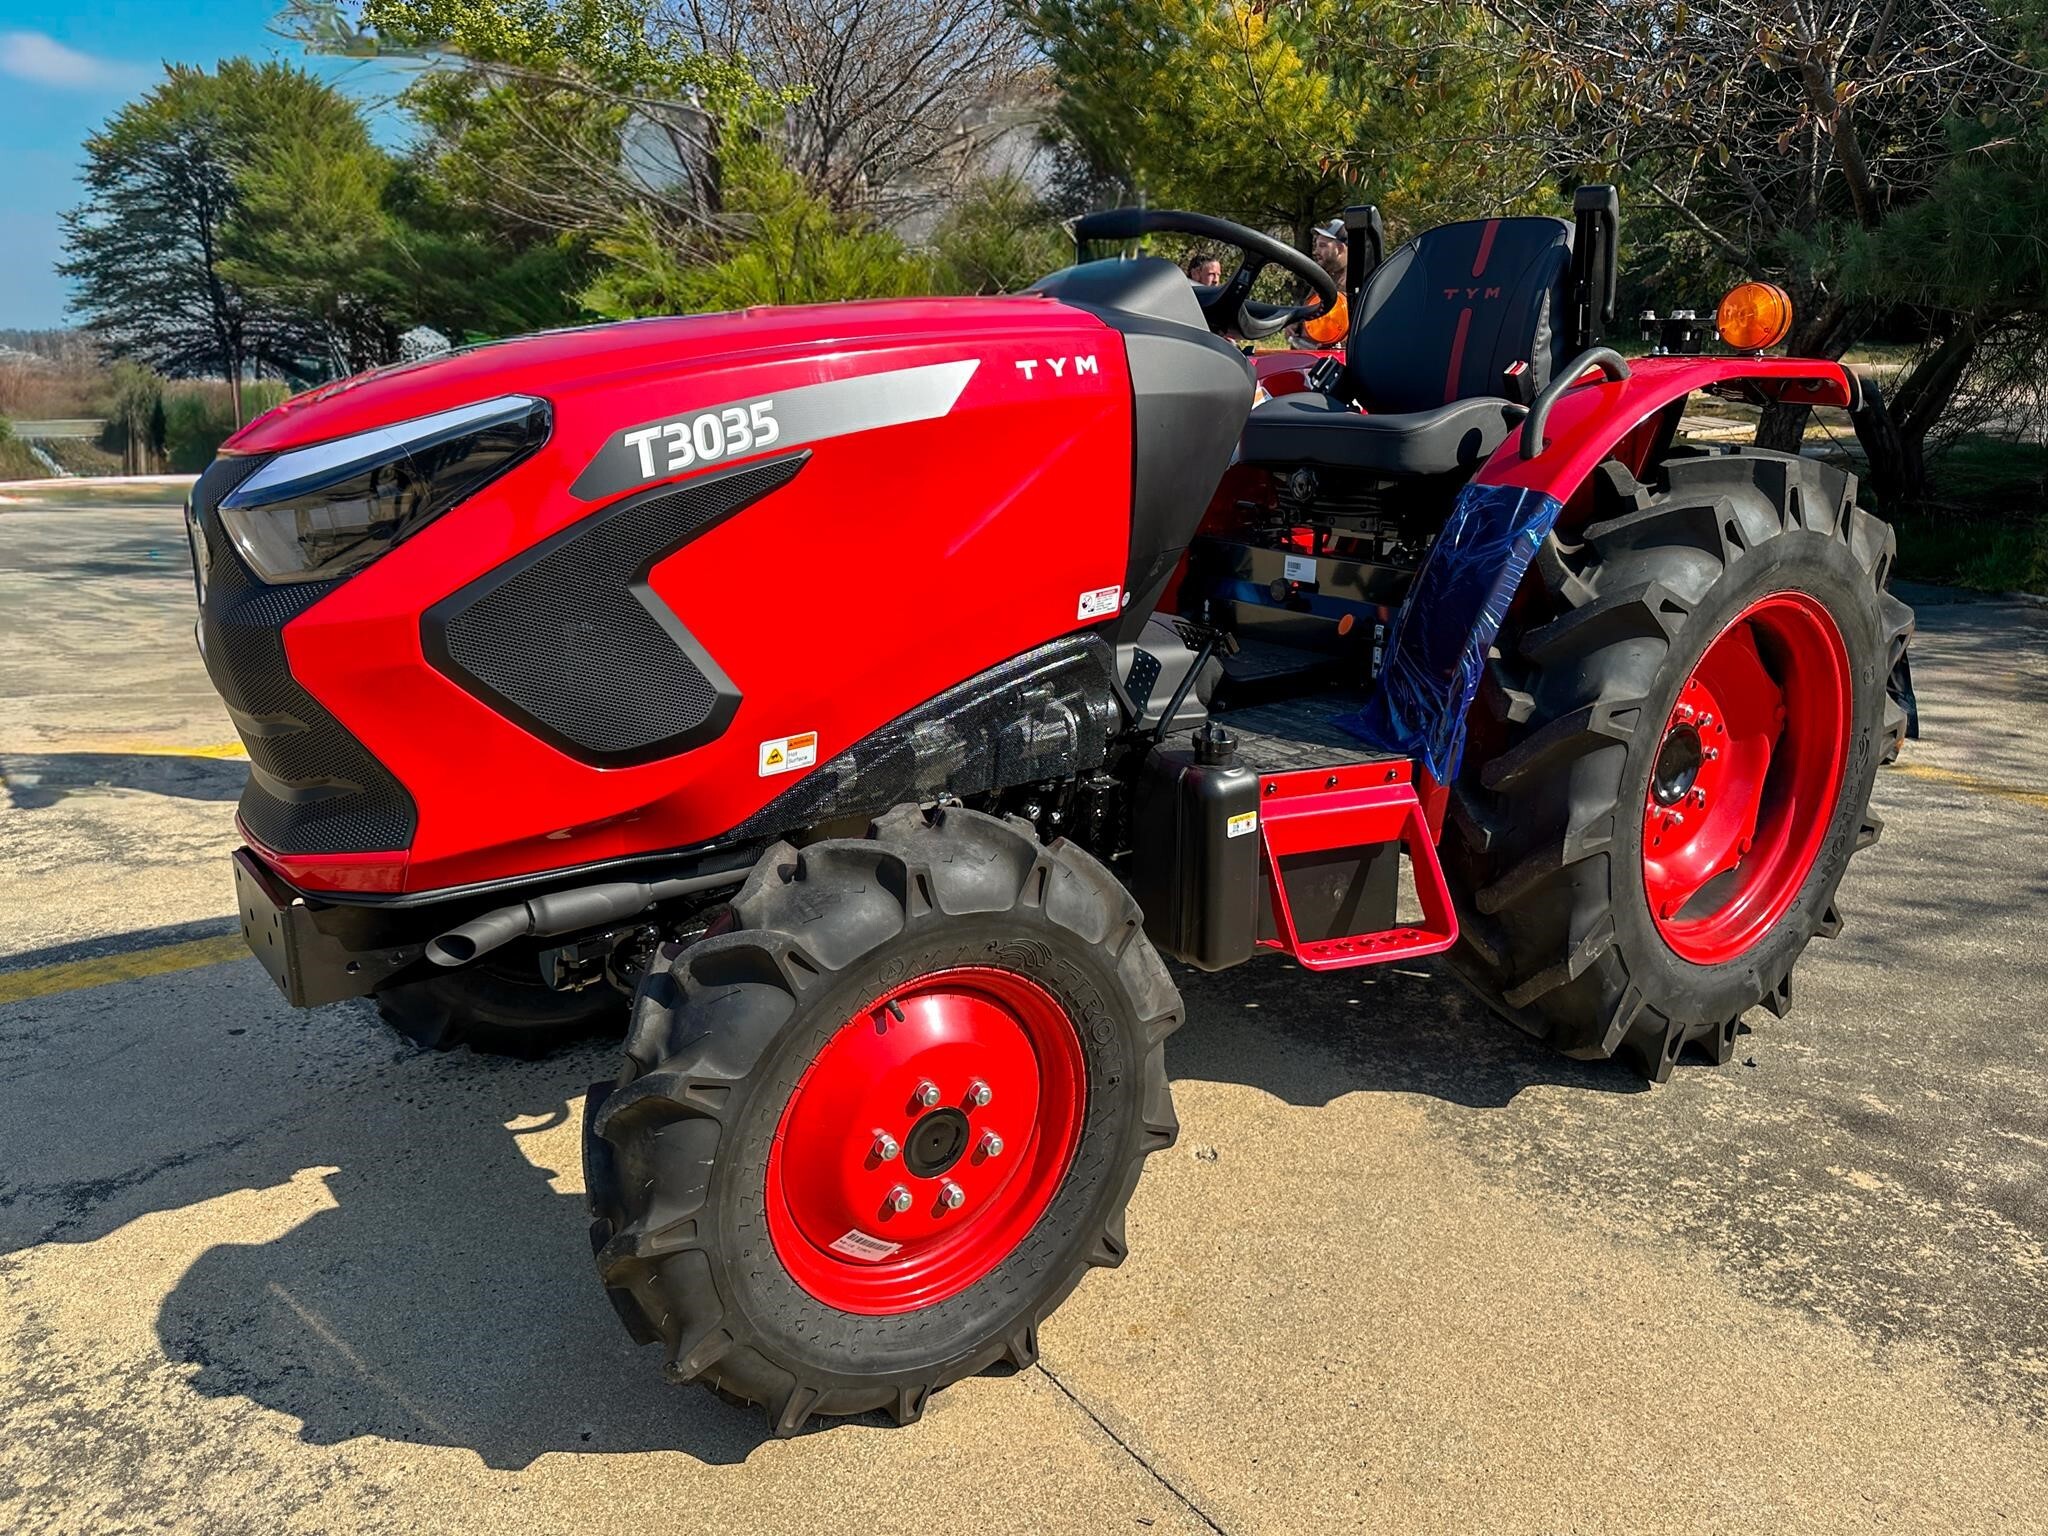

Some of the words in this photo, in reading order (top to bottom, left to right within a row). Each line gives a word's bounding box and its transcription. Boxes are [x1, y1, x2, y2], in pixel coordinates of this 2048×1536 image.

[1444, 287, 1500, 299] TYM
[1015, 355, 1098, 380] TYM
[624, 400, 779, 478] T3035
